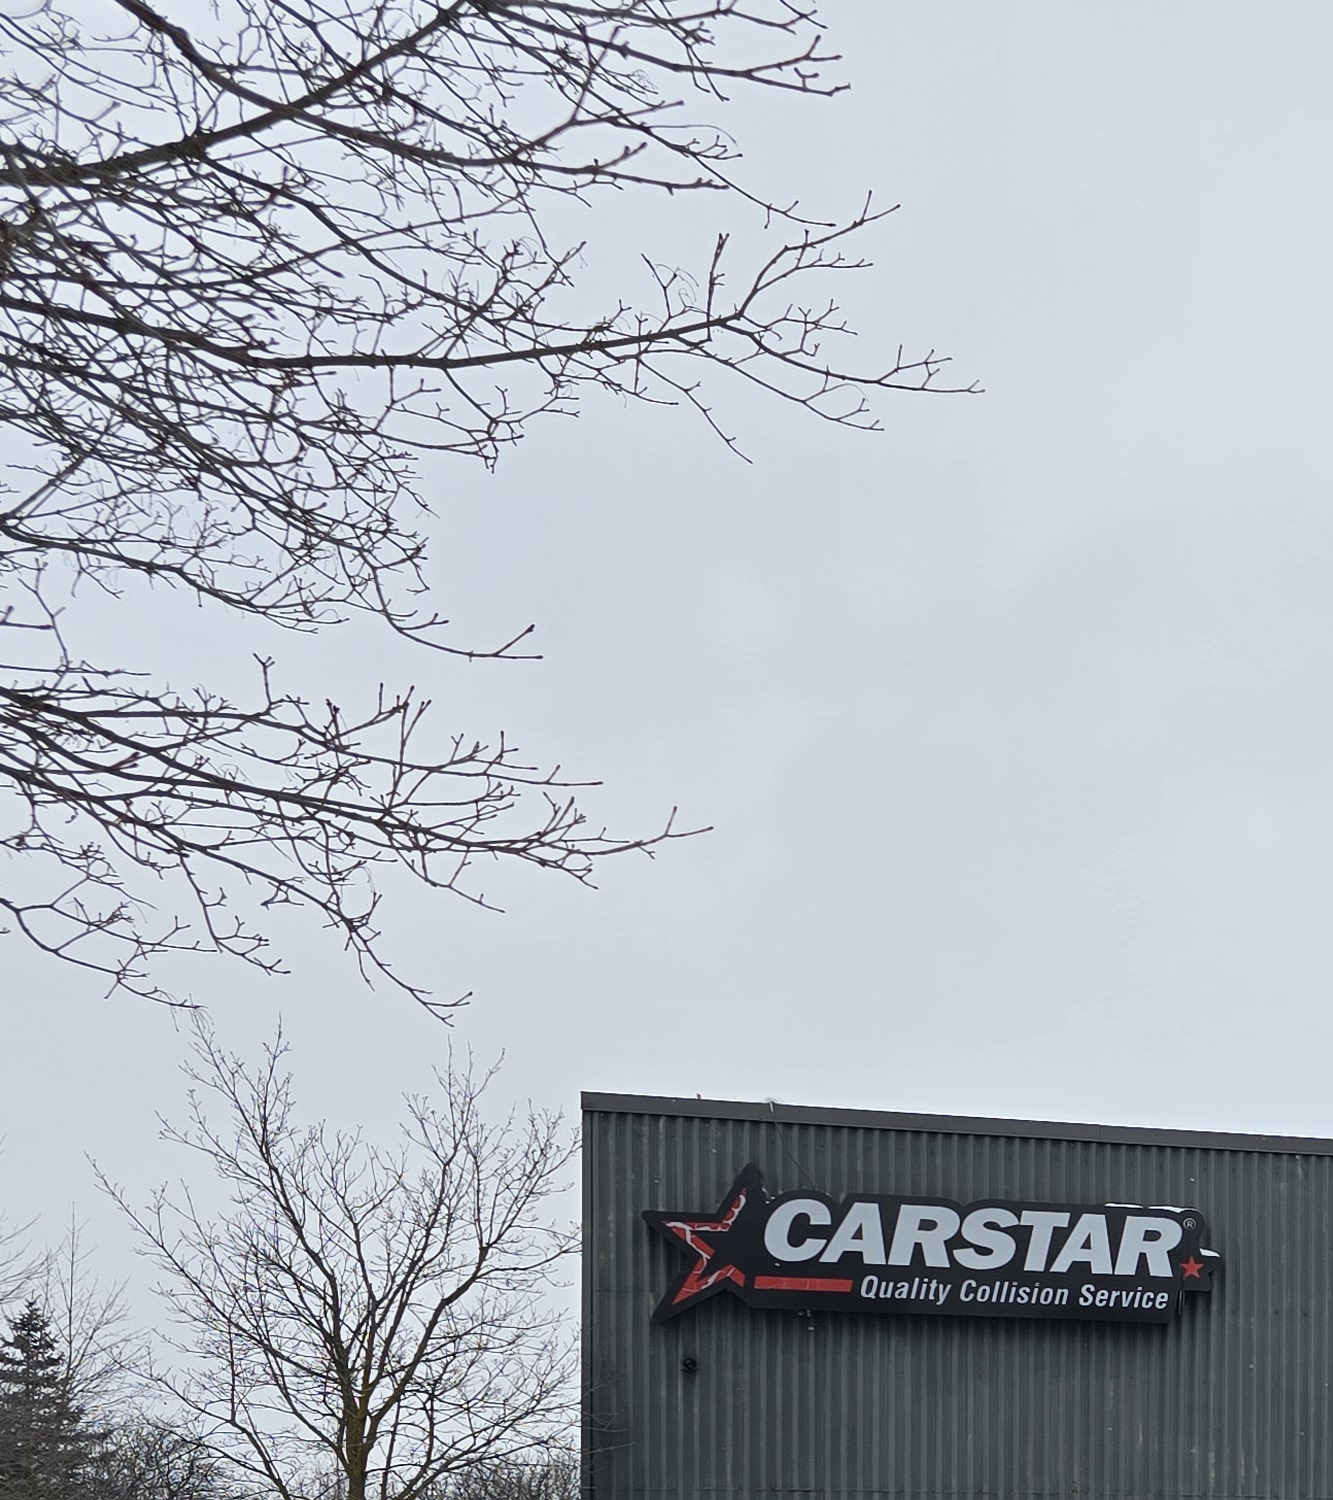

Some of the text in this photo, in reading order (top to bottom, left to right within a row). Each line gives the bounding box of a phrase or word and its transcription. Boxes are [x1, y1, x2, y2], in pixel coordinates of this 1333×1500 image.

[764, 1199, 1182, 1278] CARSTAR
[860, 1275, 1168, 1310] Quality Collision Service
